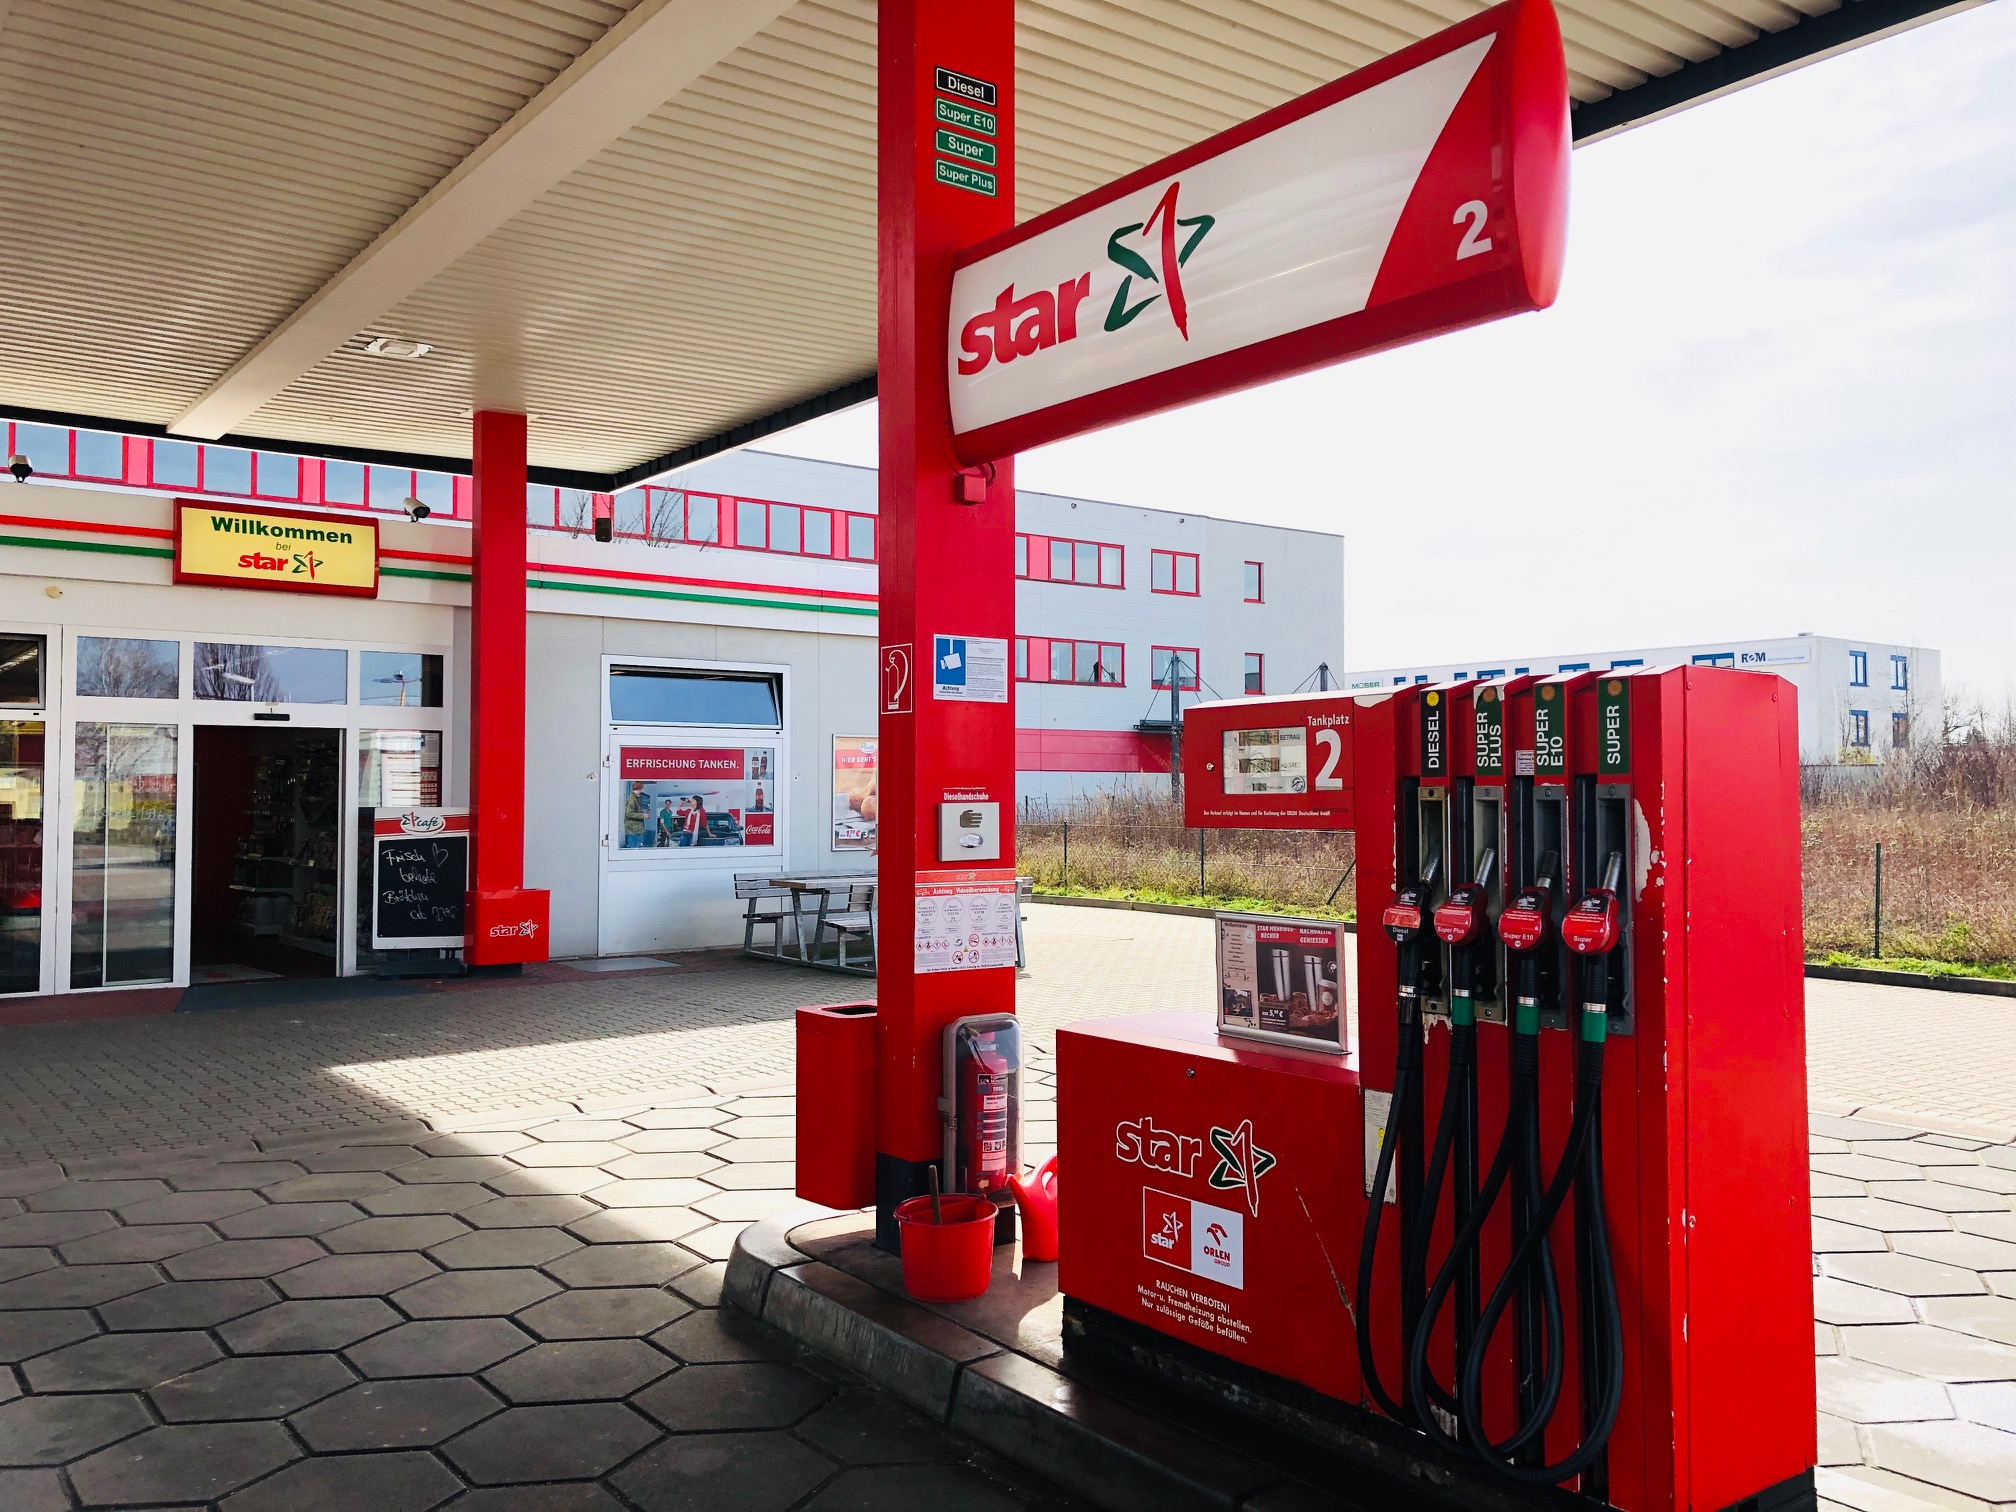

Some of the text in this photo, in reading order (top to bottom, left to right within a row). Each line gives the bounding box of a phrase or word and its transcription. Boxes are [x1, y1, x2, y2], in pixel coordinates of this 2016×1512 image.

[947, 76, 984, 98] Diesel
[939, 104, 994, 130] Super E10
[948, 136, 983, 157] Super
[939, 164, 993, 190] Super Plus
[1452, 200, 1493, 261] 2
[957, 271, 1091, 376] star
[211, 515, 352, 544] Willkommen
[275, 542, 292, 551] bei
[238, 552, 289, 571] star
[1307, 714, 1350, 727] Tankplatz
[1428, 711, 1439, 769] DIESEL
[1477, 712, 1489, 767] SUPER
[1489, 724, 1502, 767] PLUS
[1536, 708, 1549, 766] SUPER
[1607, 705, 1620, 765] SUPER
[1315, 729, 1343, 791] 2
[1550, 736, 1563, 766] E10
[626, 758, 739, 769] ERFRISCHUNG TANKEN.
[943, 792, 989, 800] Dieselhandschuhe
[416, 815, 439, 830] café
[381, 849, 426, 866] Frisch
[490, 925, 518, 938] star
[1392, 926, 1409, 934] Diesel
[1437, 926, 1452, 934] Super
[1504, 932, 1534, 941] Super E10
[1573, 935, 1592, 943] Super
[1116, 1117, 1202, 1178] star
[1151, 1232, 1175, 1250] star
[1203, 1245, 1231, 1261] ORLEN
[1214, 1259, 1230, 1267] GROUP
[1156, 1279, 1230, 1313] RAUCHEN VERBOTEN!
[1141, 1297, 1248, 1344] Nur zulässige Gefäße befüllen.
[1168, 1295, 1214, 1322] Fremdheizung
[1217, 1314, 1252, 1333] abstellen.
